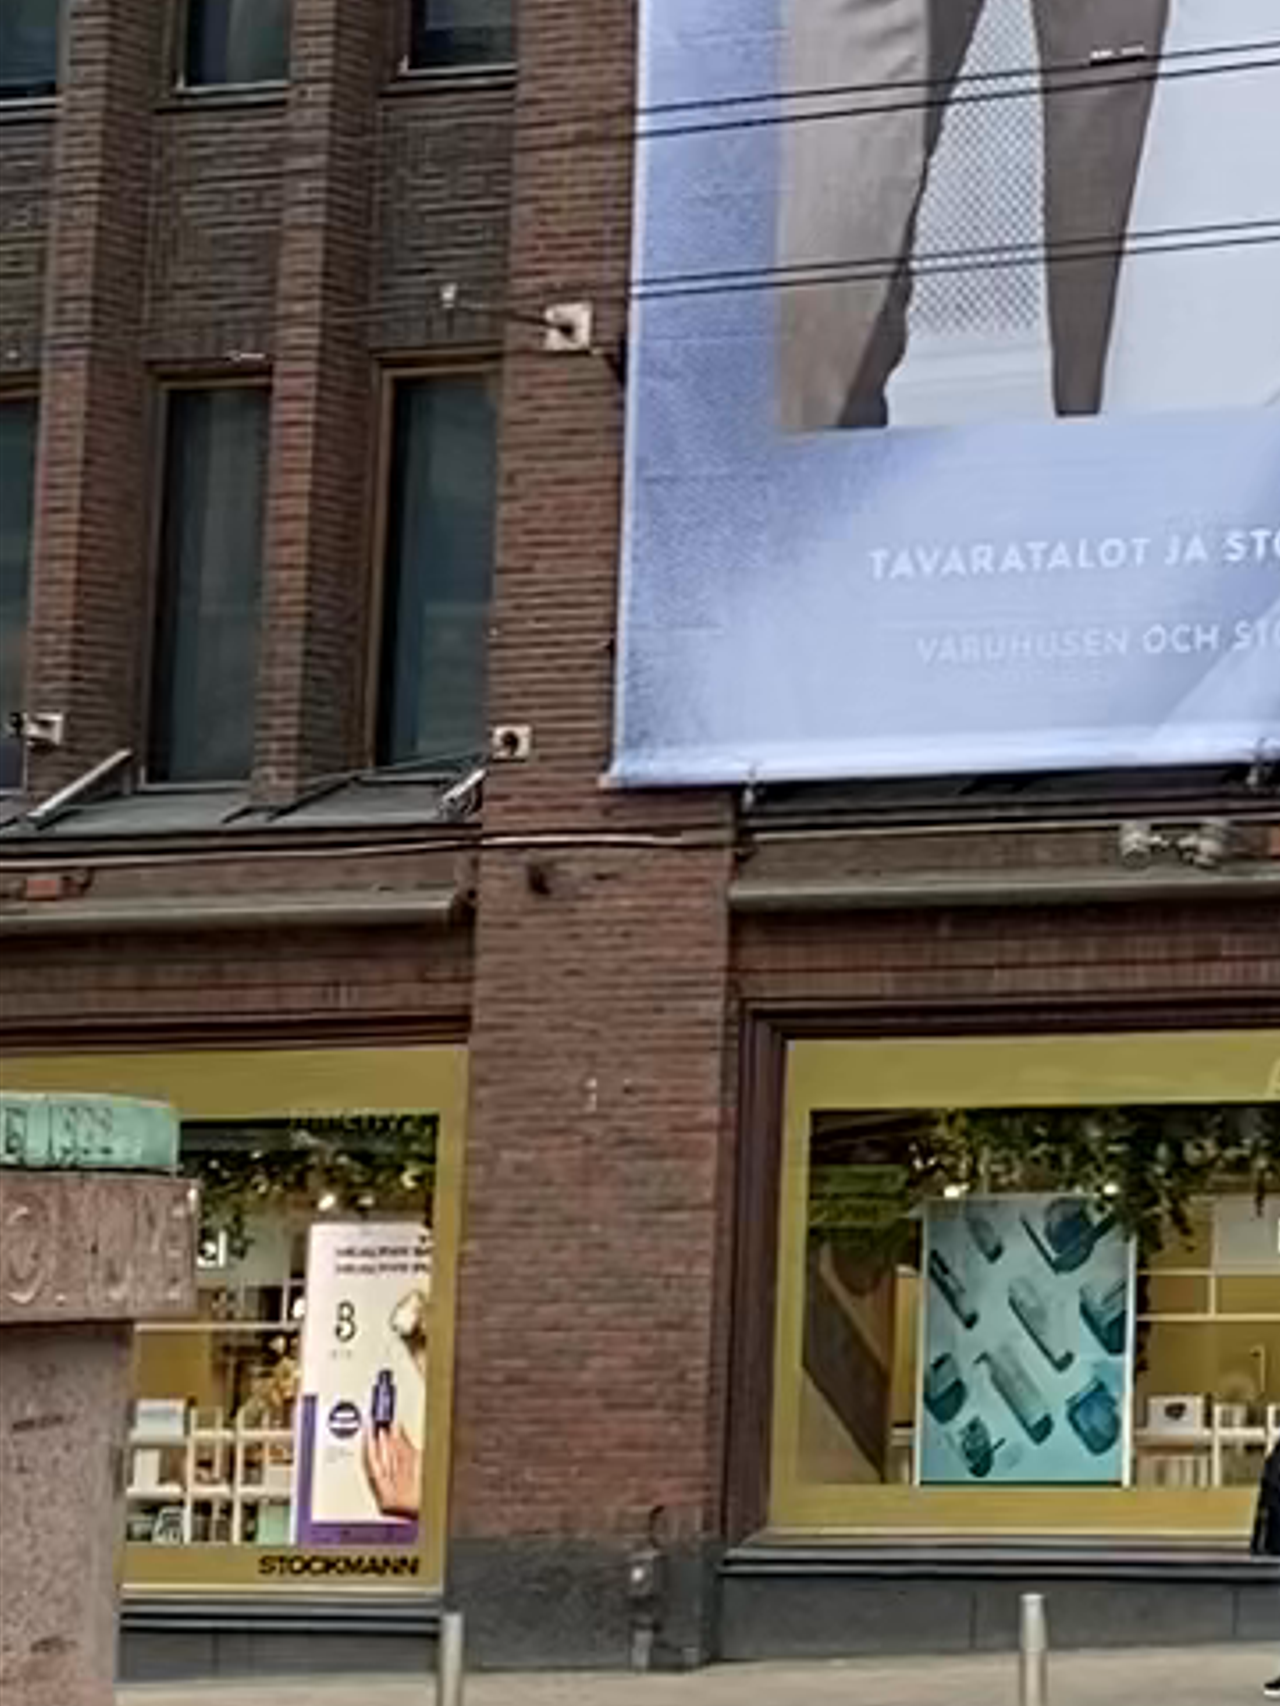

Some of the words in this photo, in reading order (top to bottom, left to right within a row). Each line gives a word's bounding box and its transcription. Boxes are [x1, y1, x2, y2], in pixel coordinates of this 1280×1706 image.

[869, 537, 1151, 580] TAVARATALOT
[1164, 534, 1209, 566] JA
[1142, 623, 1219, 654] OCH
[258, 1554, 420, 1577] STOCKMANN
